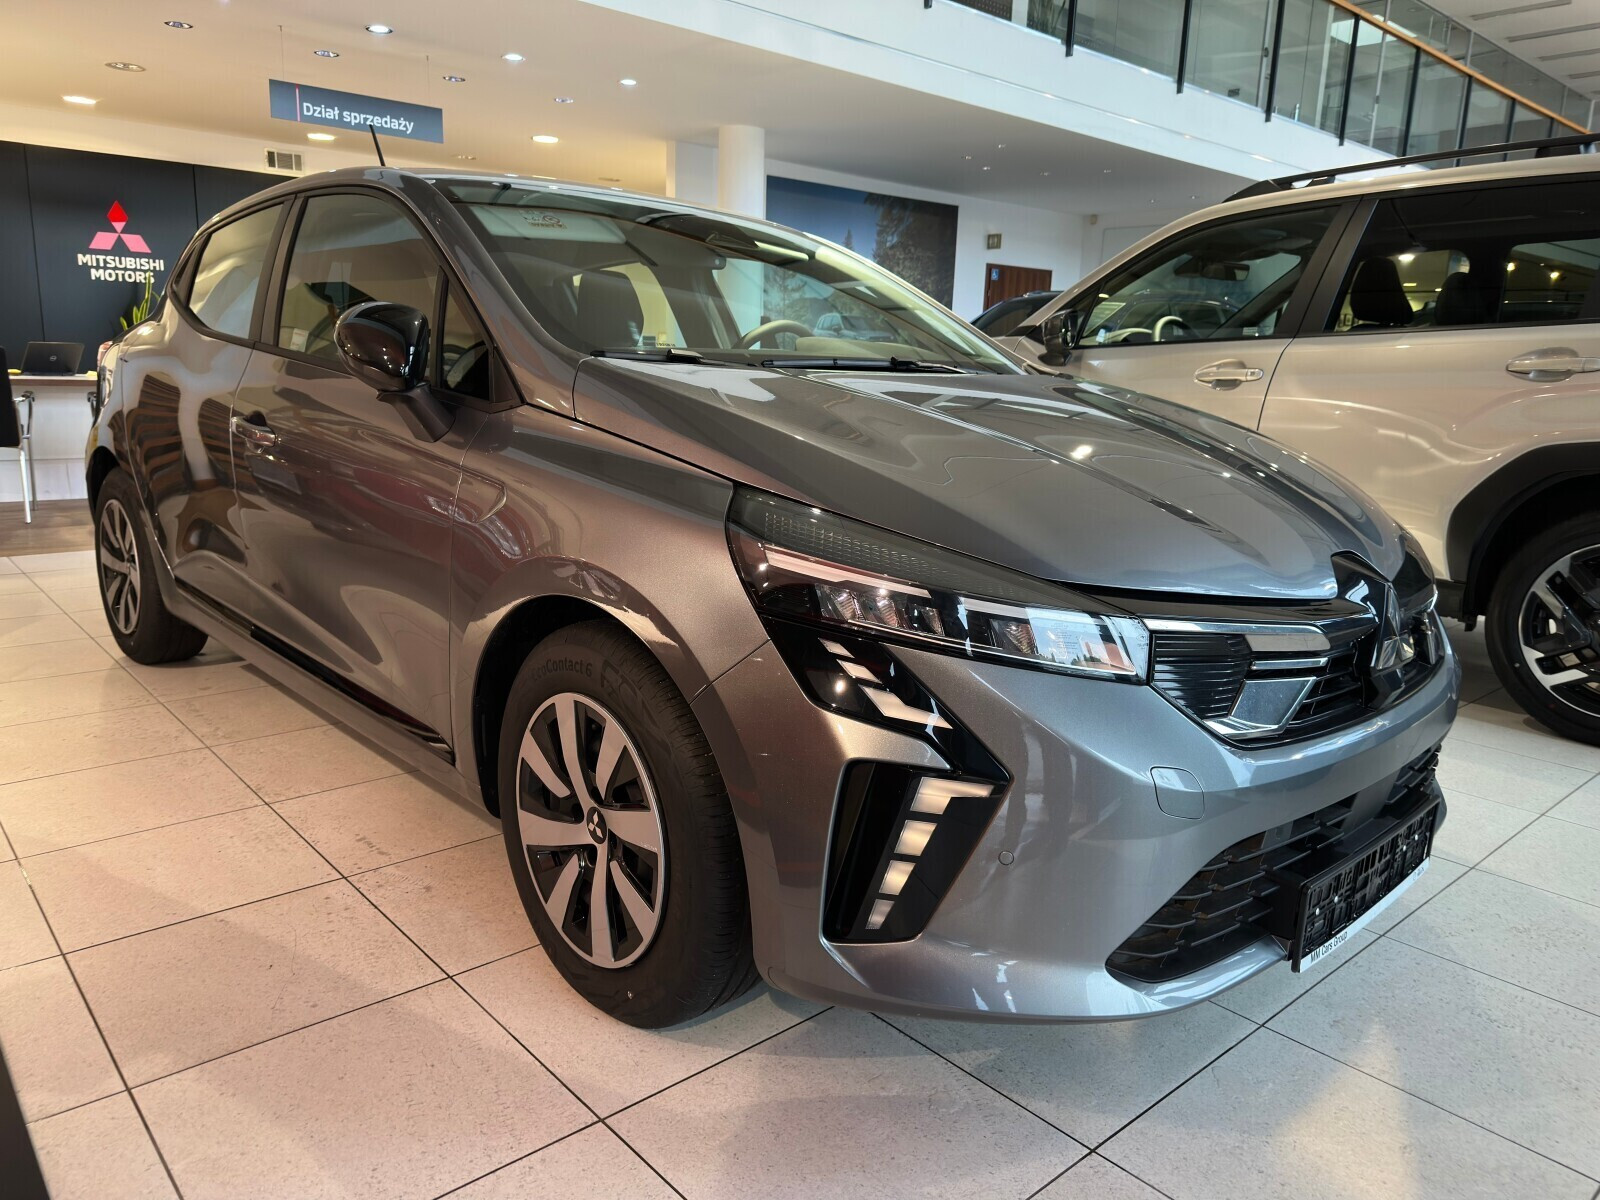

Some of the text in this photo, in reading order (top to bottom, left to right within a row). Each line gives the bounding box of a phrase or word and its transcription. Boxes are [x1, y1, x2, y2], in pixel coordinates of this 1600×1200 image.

[303, 102, 414, 134] Dział sprzedaży
[77, 253, 165, 271] MITSUBISHI
[585, 662, 593, 678] 6
[1310, 931, 1348, 963] MM Cars Group
